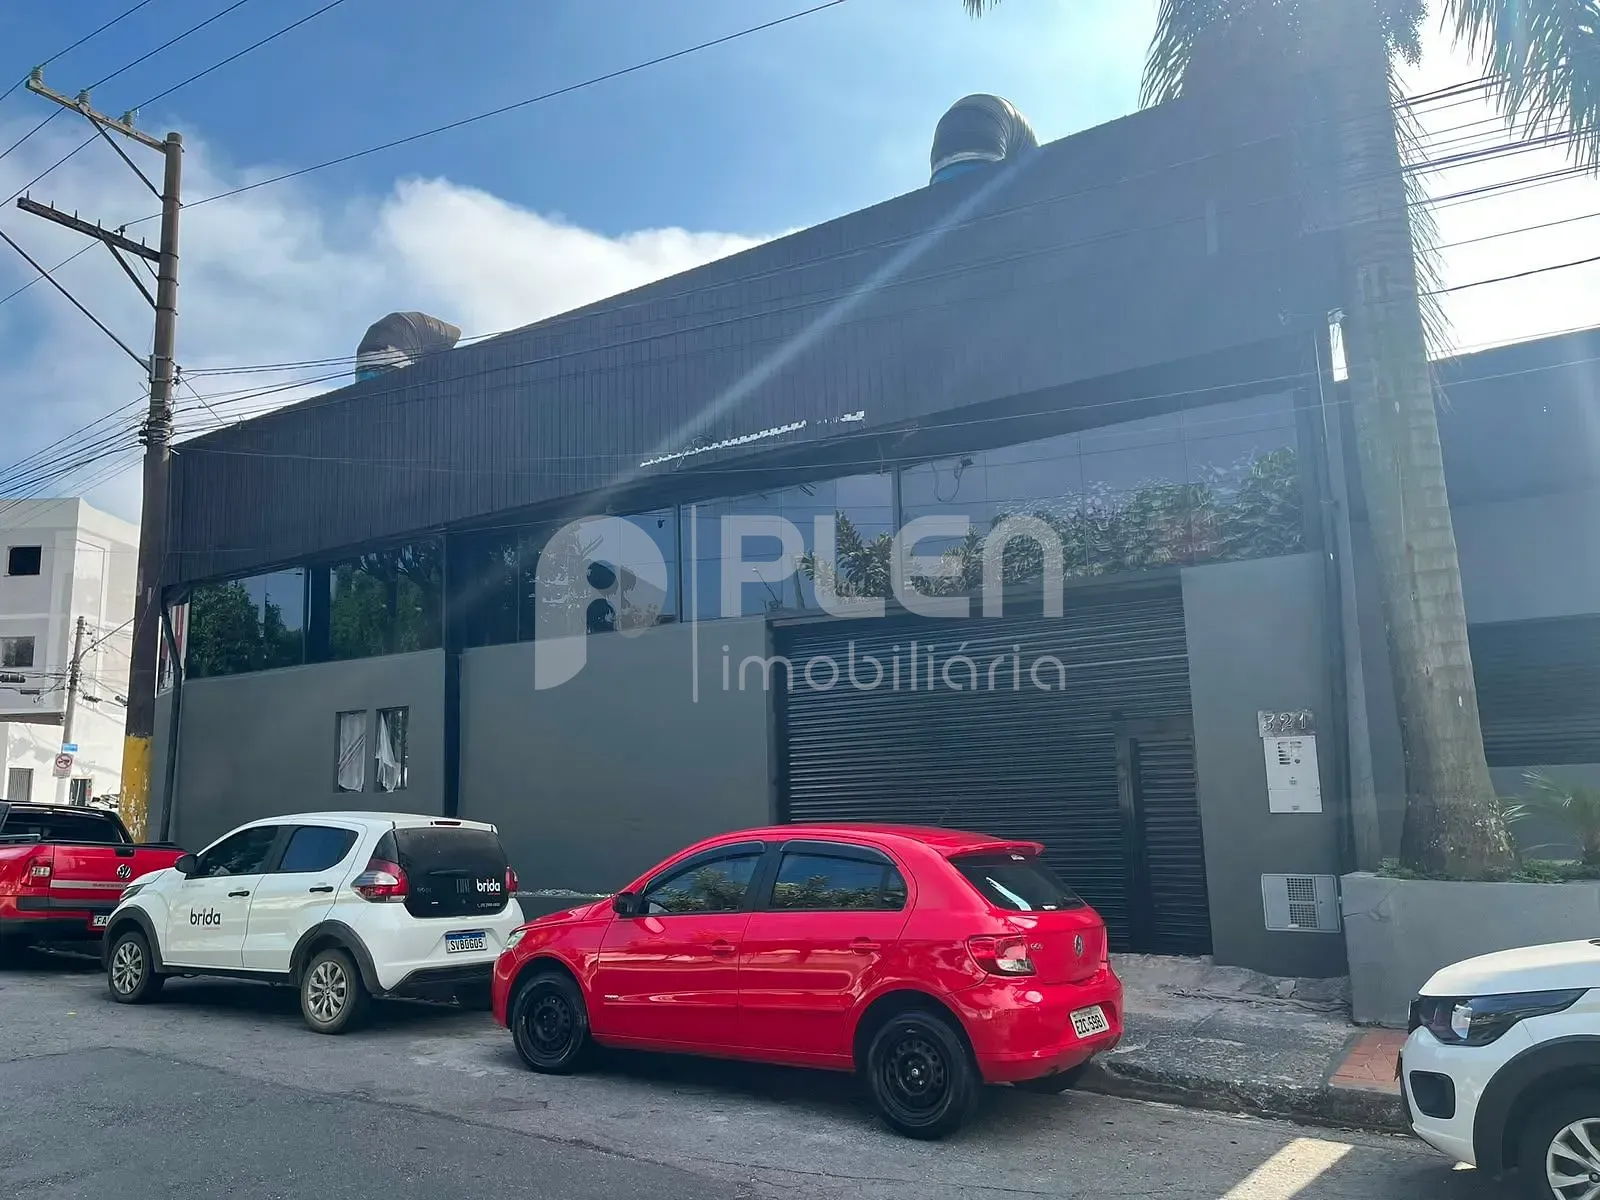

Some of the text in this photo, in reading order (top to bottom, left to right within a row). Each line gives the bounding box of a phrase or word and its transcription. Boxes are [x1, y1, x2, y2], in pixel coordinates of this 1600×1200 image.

[1262, 712, 1306, 731] 321
[476, 878, 501, 892] brida
[190, 907, 221, 925] brida
